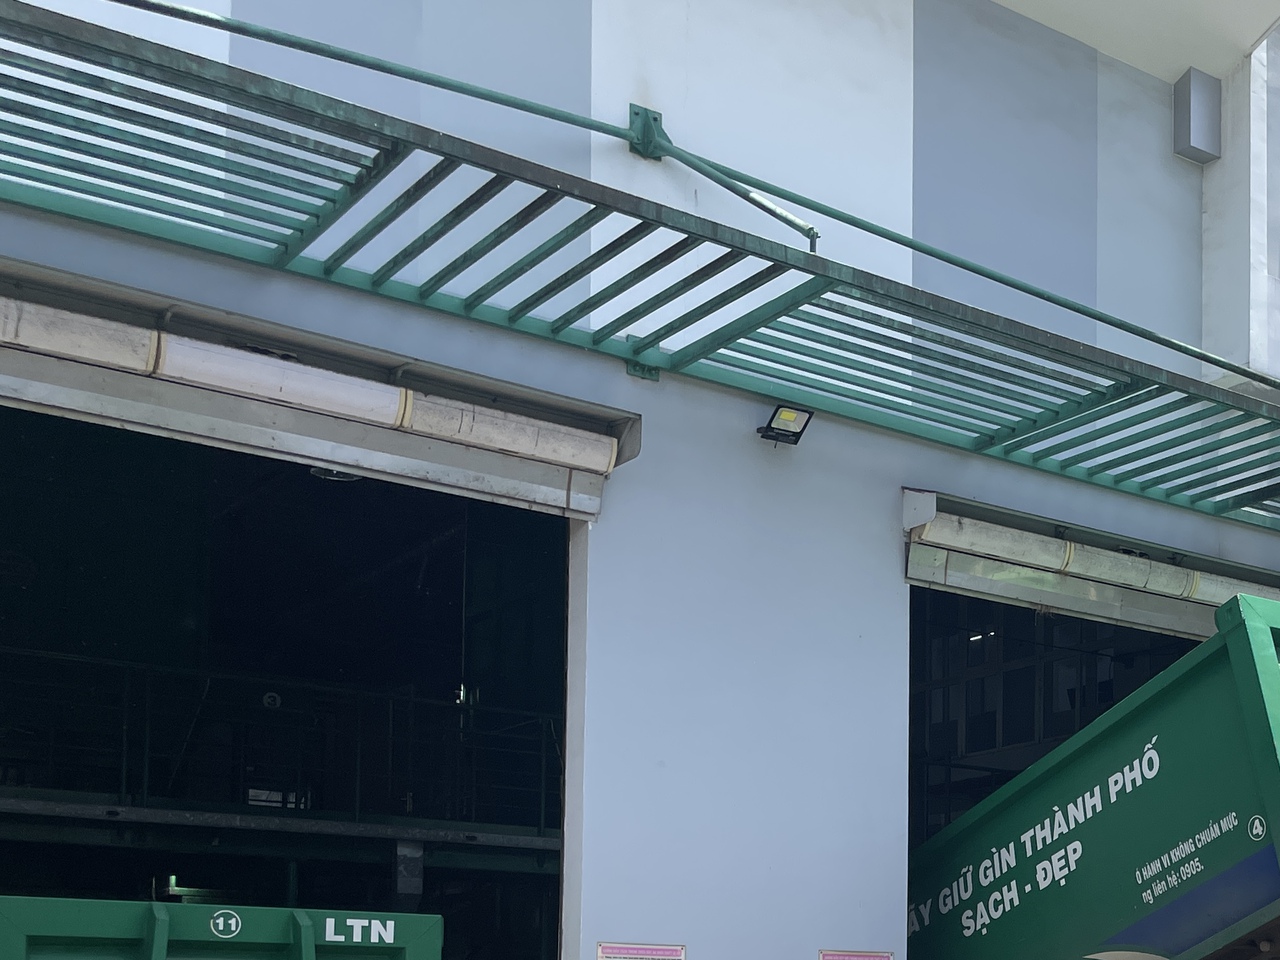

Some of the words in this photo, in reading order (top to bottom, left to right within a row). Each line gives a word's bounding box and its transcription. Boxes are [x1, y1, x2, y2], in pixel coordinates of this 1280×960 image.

[938, 865, 973, 915] GIỮ
[978, 841, 1017, 887] GÌN
[1020, 784, 1103, 858] THÀNH
[1107, 734, 1160, 804] PHỐ
[1142, 858, 1162, 881] HÀNH
[1161, 853, 1171, 868] VI
[1170, 838, 1196, 863] KHÔNG
[1195, 820, 1221, 849] CHUẨN
[1220, 811, 1239, 832] MỰC
[961, 879, 1020, 937] SẠCH
[1035, 840, 1083, 891] ĐẸP
[1151, 880, 1167, 897] liên
[215, 916, 237, 931] 11
[325, 917, 395, 944] LTN
